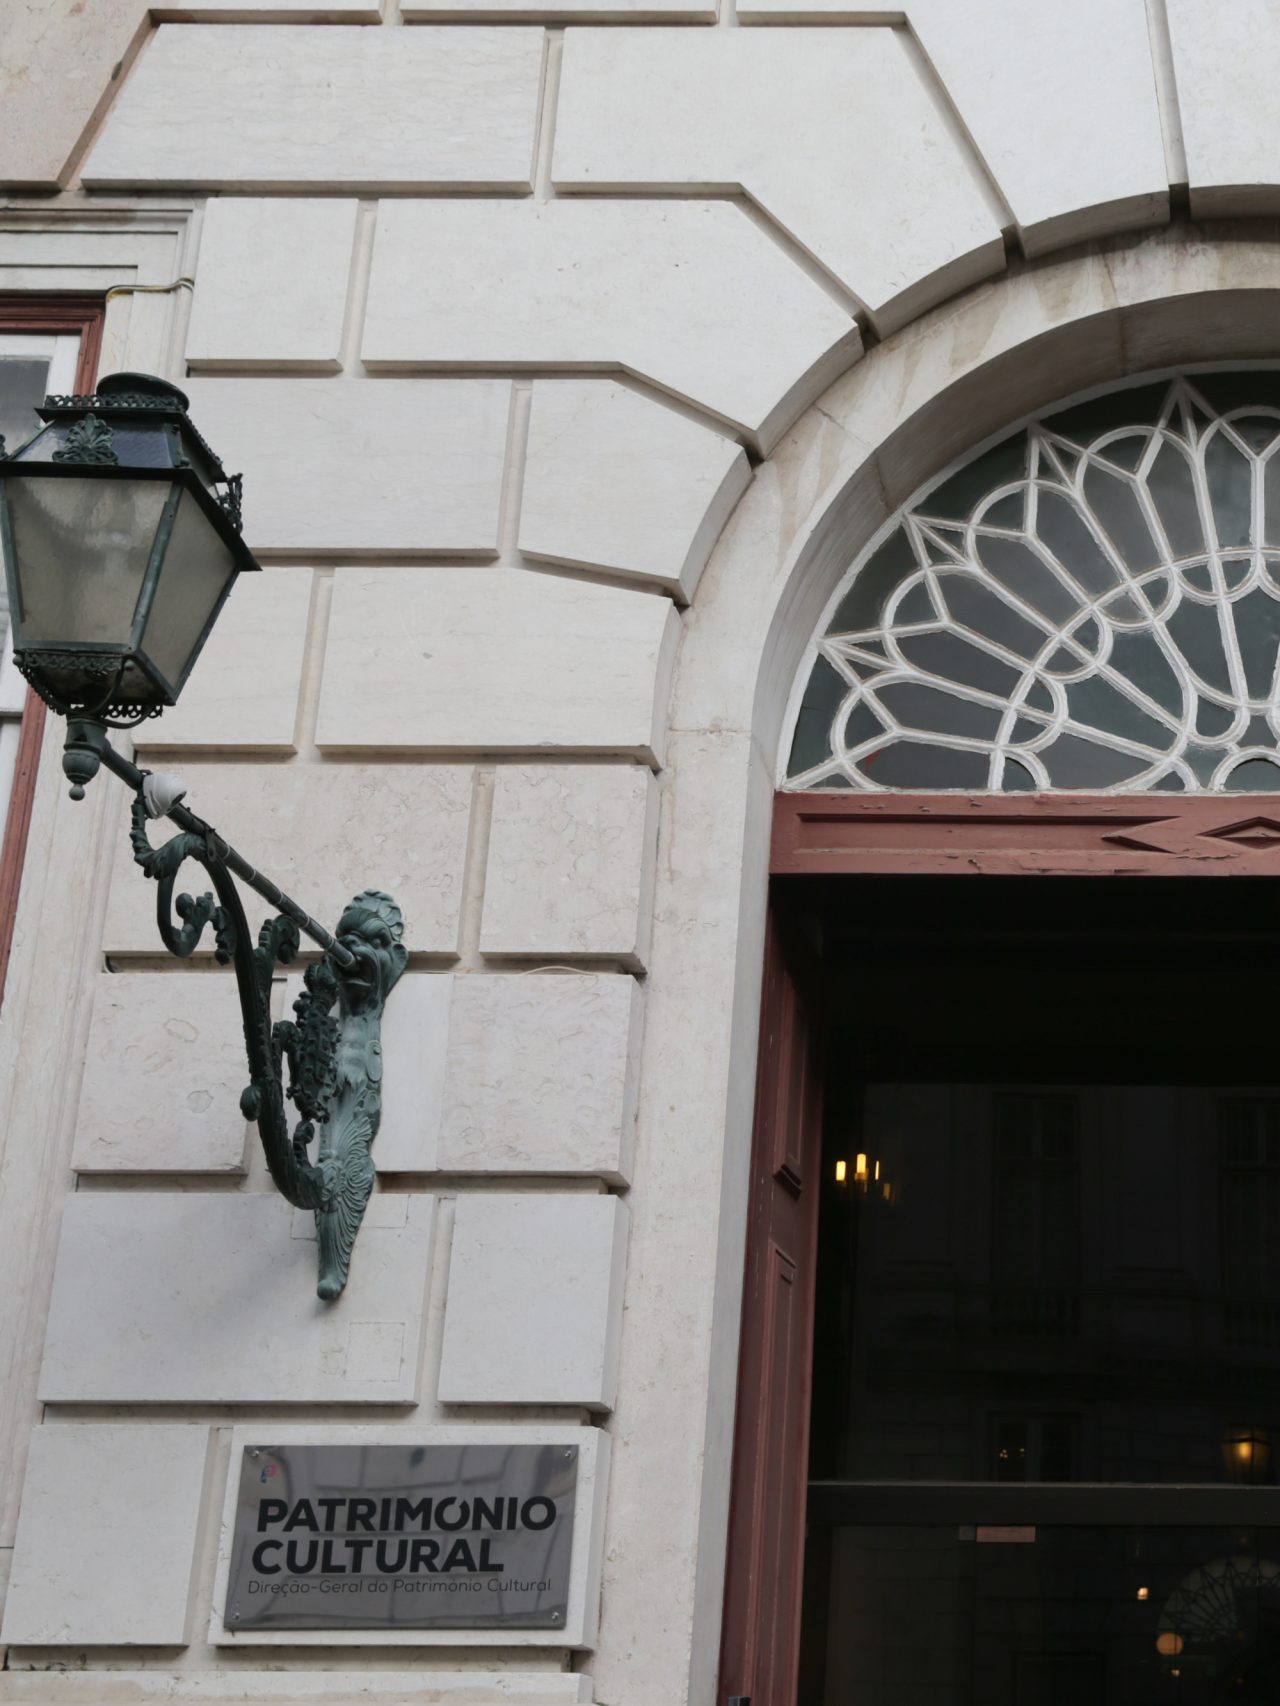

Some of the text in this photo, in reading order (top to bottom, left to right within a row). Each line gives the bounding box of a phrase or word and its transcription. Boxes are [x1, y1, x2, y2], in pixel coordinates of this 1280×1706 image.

[251, 1538, 504, 1574] CULTURAL
[248, 1579, 363, 1597] Direção-Geral
[367, 1579, 388, 1593] do
[487, 1577, 551, 1592] Cultural
